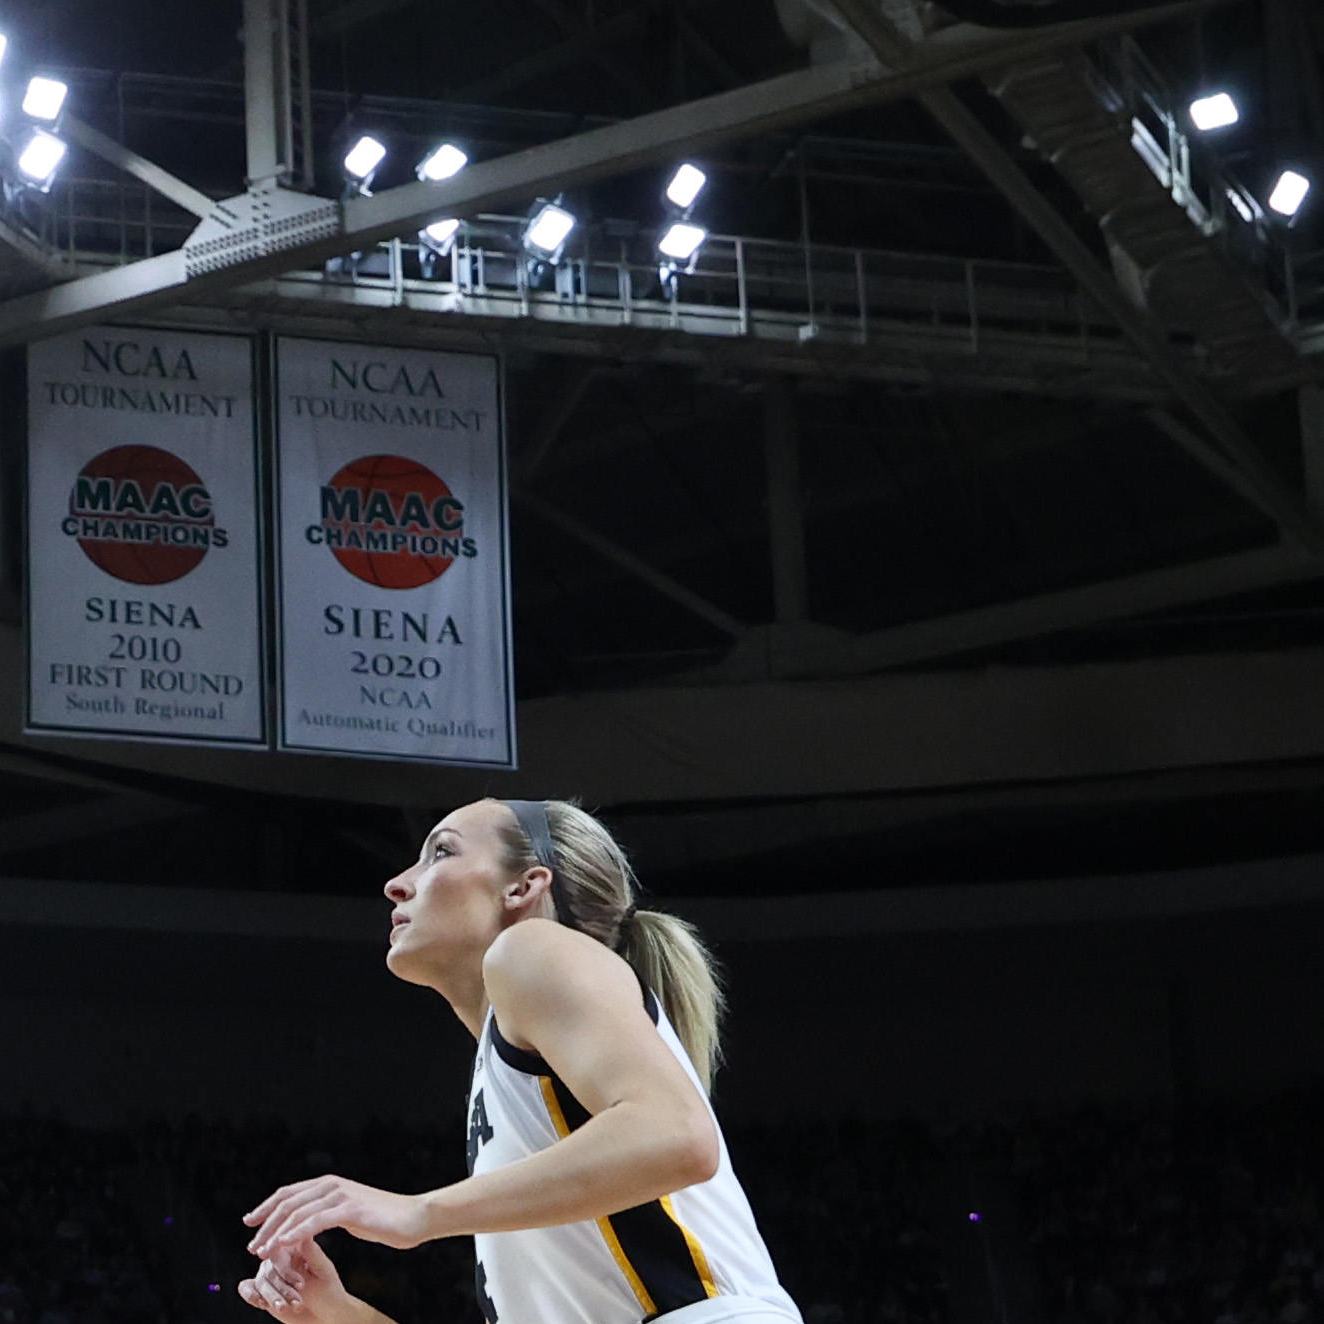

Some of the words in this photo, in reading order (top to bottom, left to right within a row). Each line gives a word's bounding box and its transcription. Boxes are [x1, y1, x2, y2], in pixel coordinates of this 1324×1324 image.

[81, 338, 199, 381] NCAA
[330, 358, 446, 400] NCAA
[45, 381, 235, 418] TOURNAMENT
[288, 395, 487, 432] TOURNAMENT
[77, 478, 212, 518] MAAC
[319, 485, 465, 531] MAAC
[61, 516, 229, 548] CHAMPIONS
[305, 525, 478, 558] CHAMPIONS
[85, 596, 203, 630] SIENA
[323, 604, 464, 645] SIENA
[108, 633, 182, 663] 2010
[50, 663, 127, 688] FIRST
[140, 668, 243, 695] ROUND
[350, 651, 442, 679] 2020
[65, 694, 125, 714] South
[134, 696, 225, 721] Regional
[360, 685, 432, 710] NCAA
[298, 708, 401, 733] Automatic
[406, 716, 496, 740] Qualifier
